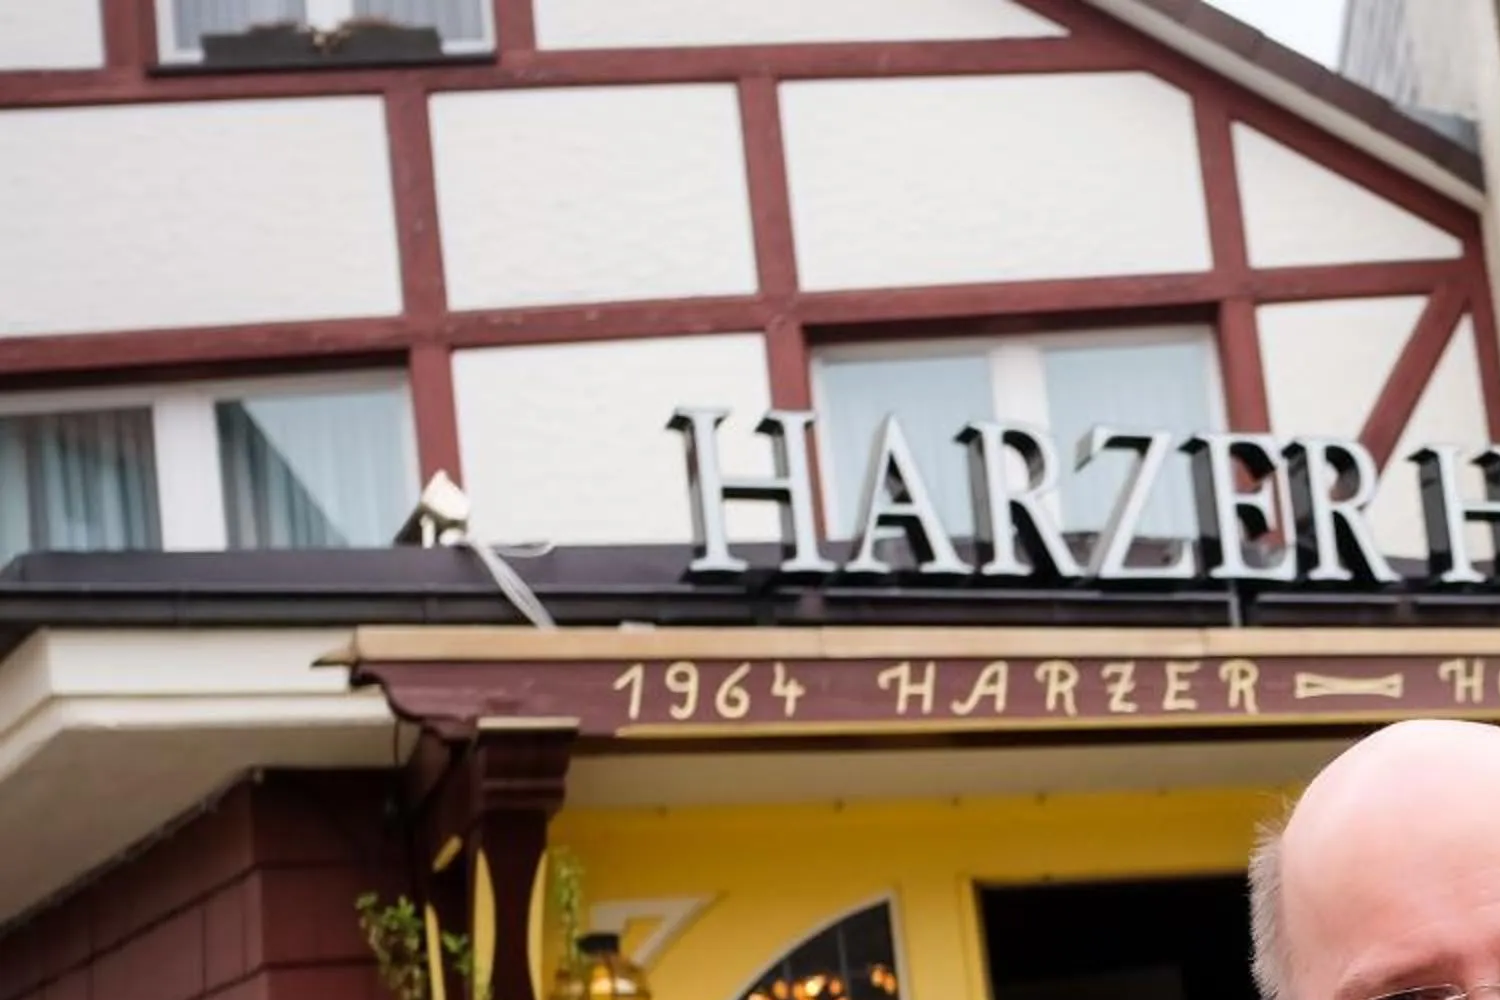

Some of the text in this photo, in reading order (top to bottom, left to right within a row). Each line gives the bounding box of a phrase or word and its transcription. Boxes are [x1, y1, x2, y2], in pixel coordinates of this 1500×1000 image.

[666, 407, 1403, 584] HARZER
[612, 660, 806, 721] 1964
[876, 657, 1261, 716] HARZER
